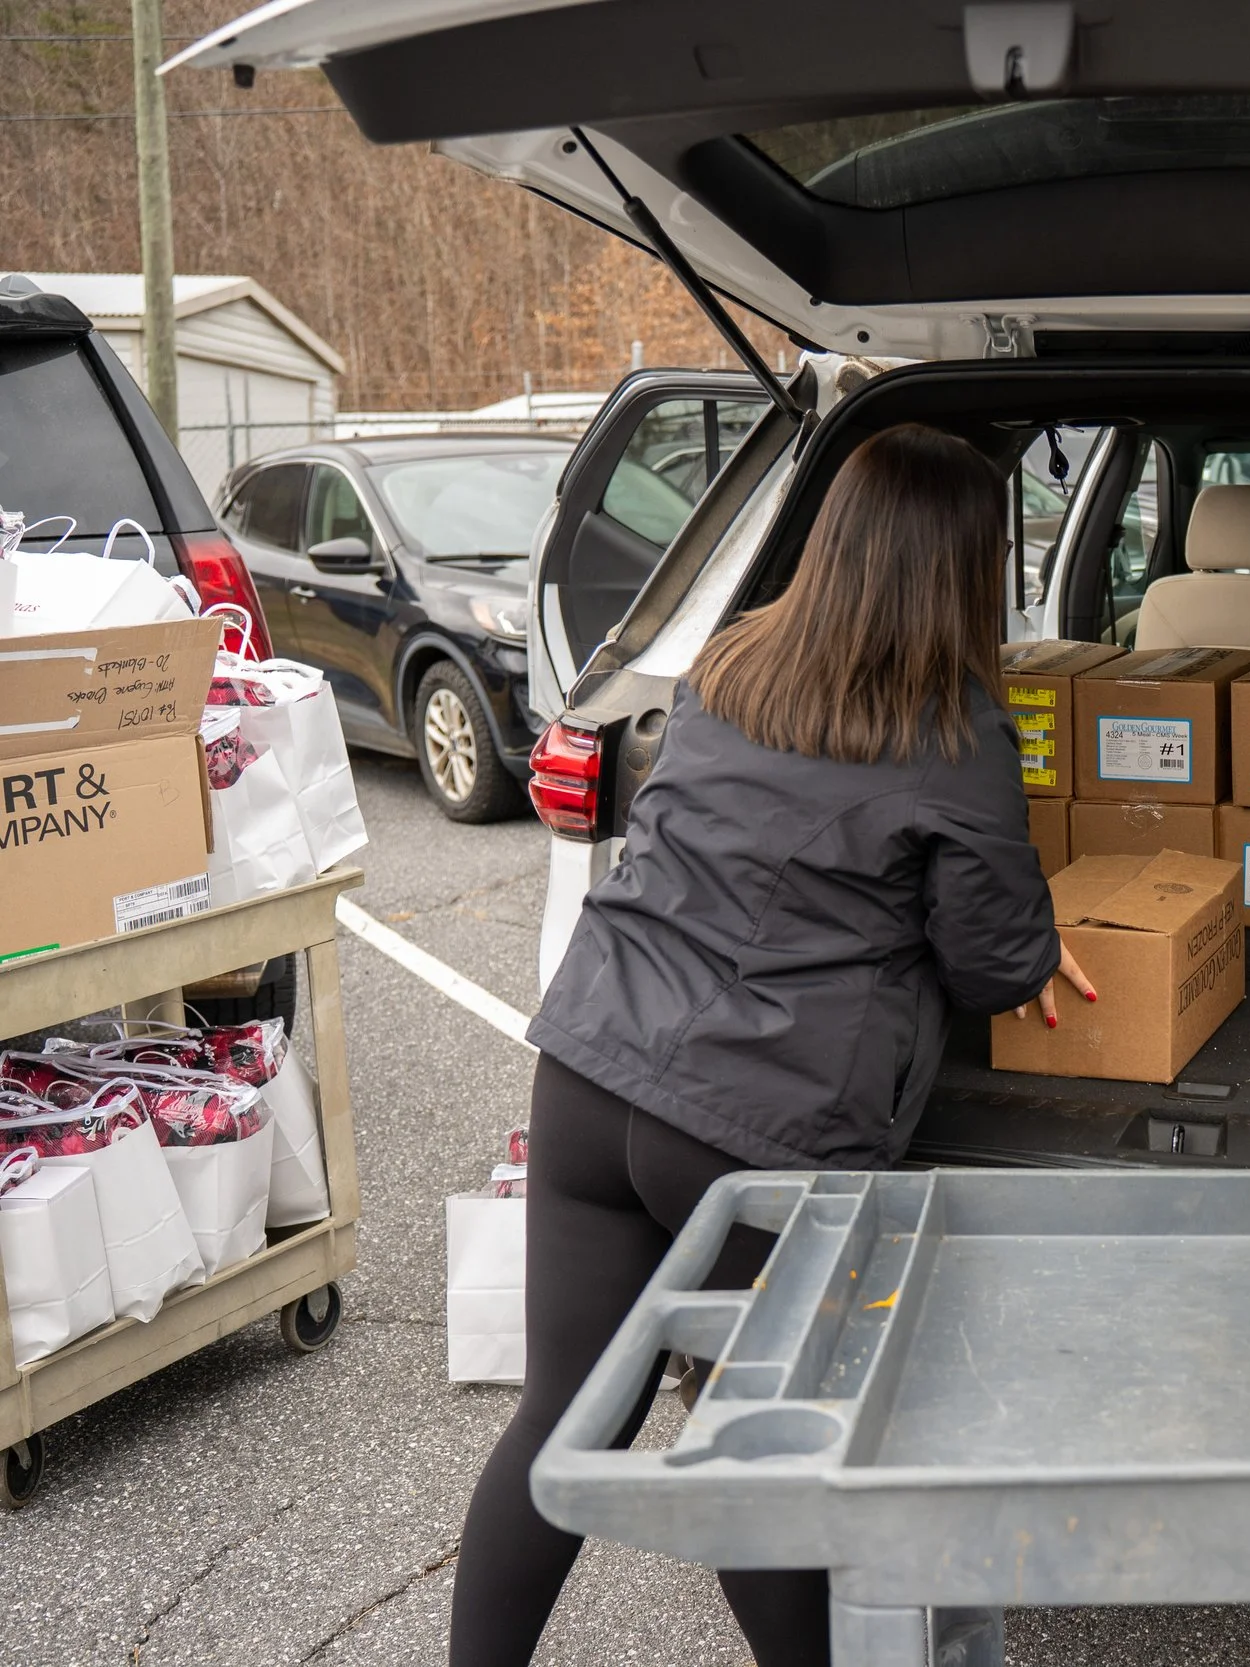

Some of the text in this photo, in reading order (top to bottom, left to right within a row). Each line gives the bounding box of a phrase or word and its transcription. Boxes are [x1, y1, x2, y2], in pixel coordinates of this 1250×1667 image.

[67, 687, 107, 705] Brooks
[116, 680, 154, 700] Eugene
[1106, 731, 1123, 739] 4324
[1160, 743, 1184, 756] #1
[75, 763, 110, 800] &
[134, 889, 153, 899] COMPANY
[1187, 918, 1217, 962] FROZEN
